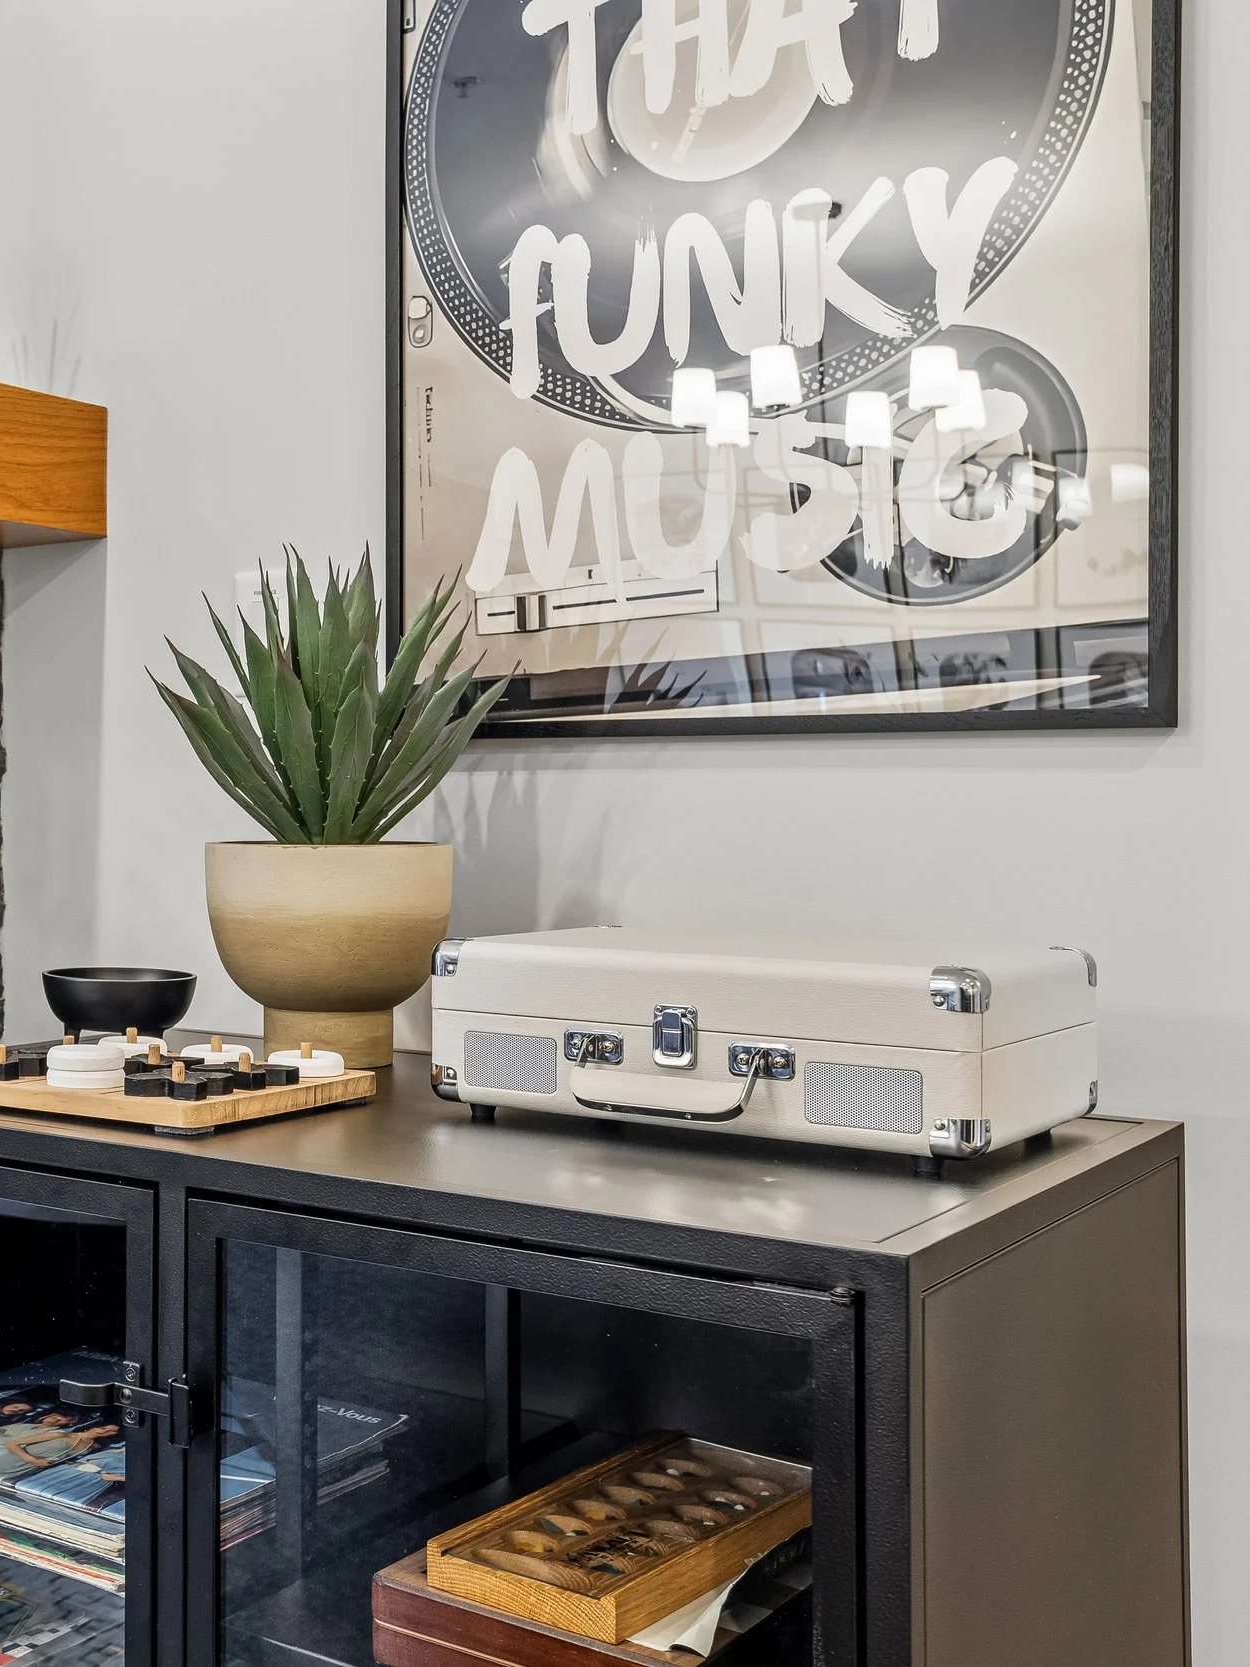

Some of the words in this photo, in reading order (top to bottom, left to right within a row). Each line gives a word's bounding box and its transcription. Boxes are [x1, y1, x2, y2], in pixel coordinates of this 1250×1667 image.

[500, 157, 1018, 399] FUNKY
[466, 388, 1028, 603] MUSIC
[317, 1403, 382, 1425] z-Vous
